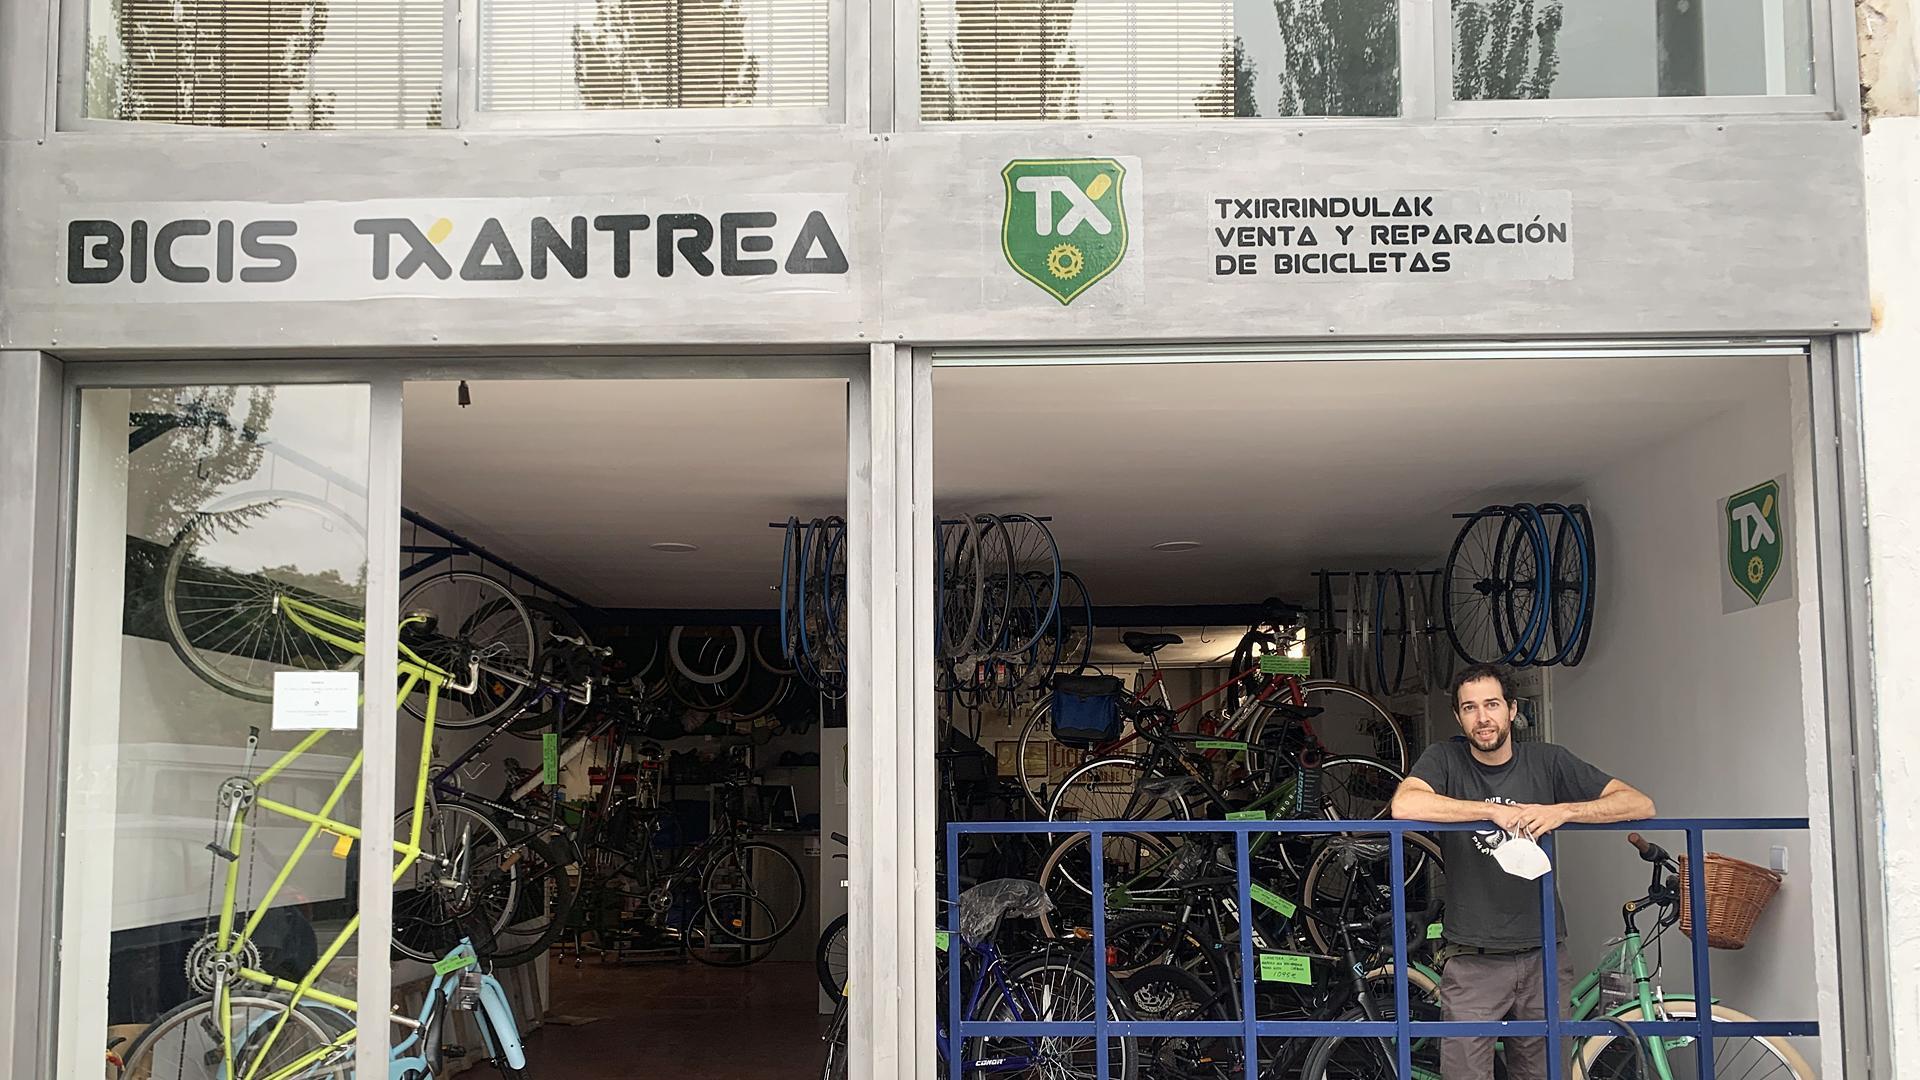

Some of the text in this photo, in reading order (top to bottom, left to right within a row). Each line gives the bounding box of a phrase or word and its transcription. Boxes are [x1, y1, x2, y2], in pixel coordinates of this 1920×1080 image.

[1016, 173, 1112, 236] TX
[1214, 196, 1434, 219] TXIRRINDULAK
[67, 210, 850, 284] BICIS TXANTREA
[1214, 215, 1568, 248] VENTA Y REPARACIÓN
[1215, 251, 1451, 276] DE BICICLETAS
[1732, 494, 1776, 553] TX
